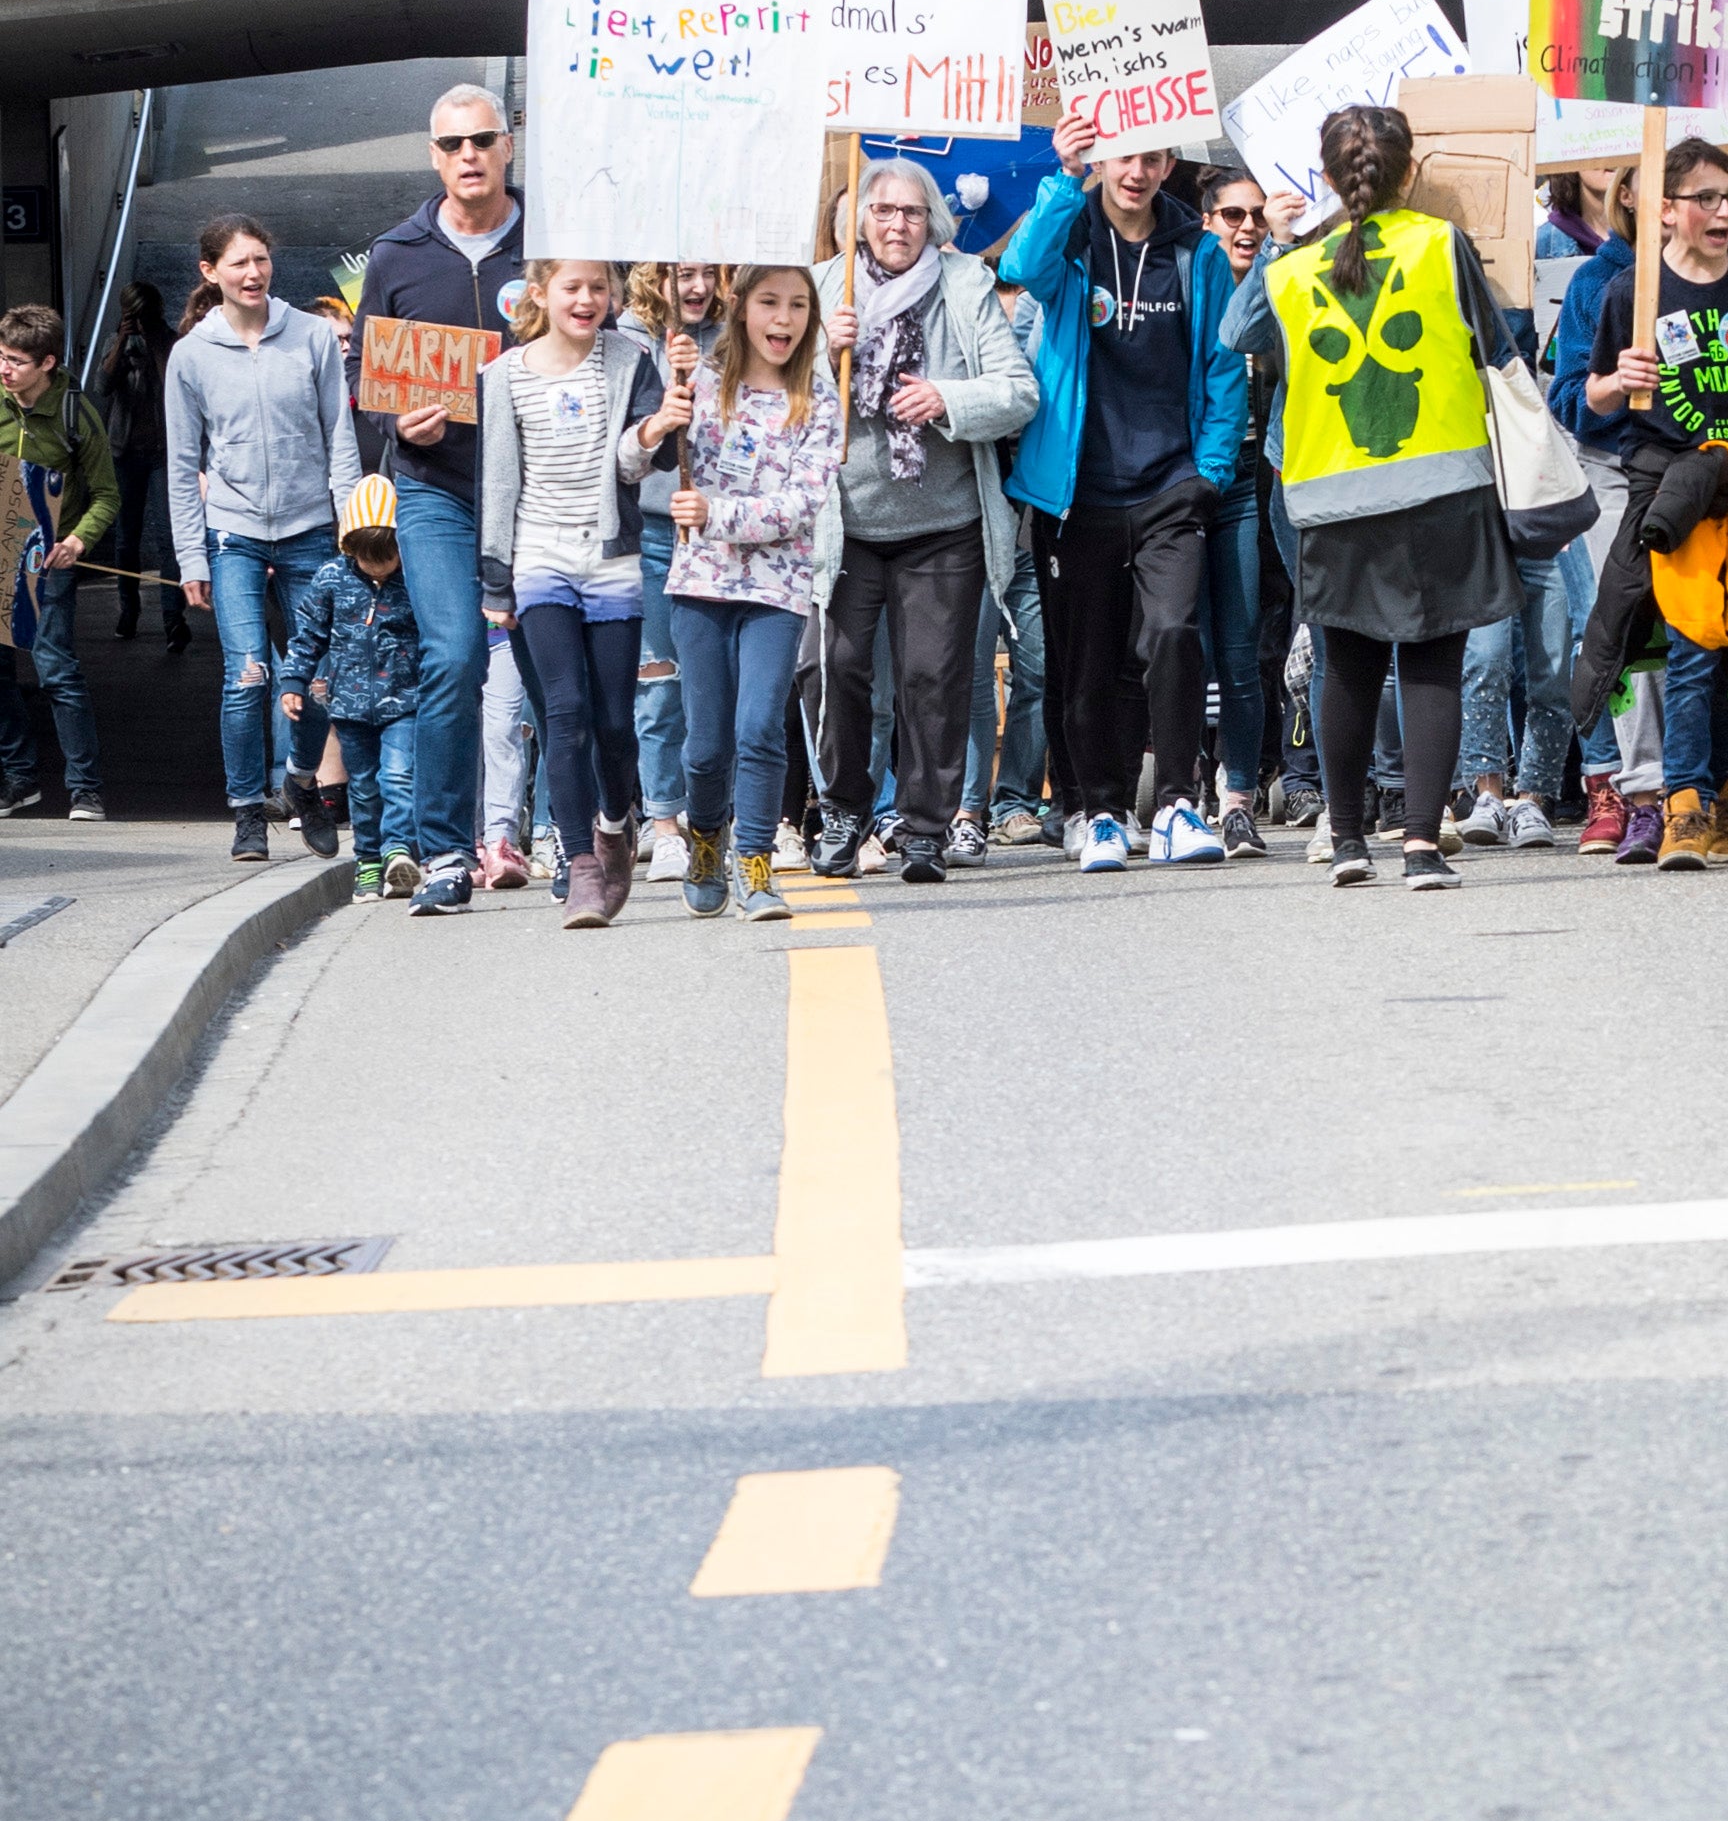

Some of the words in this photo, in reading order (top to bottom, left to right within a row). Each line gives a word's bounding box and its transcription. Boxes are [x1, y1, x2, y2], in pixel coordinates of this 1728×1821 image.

[1053, 2, 1117, 35] Bier
[1057, 26, 1142, 63] wenn's
[1152, 16, 1201, 36] warm
[569, 47, 614, 80] die
[1113, 51, 1168, 76] ischs
[1254, 74, 1316, 122] like
[1324, 24, 1382, 71] naps
[864, 65, 898, 86] es
[904, 53, 1016, 123] Mittli
[1069, 69, 1214, 139] SCHEISSE
[363, 378, 398, 409] IM
